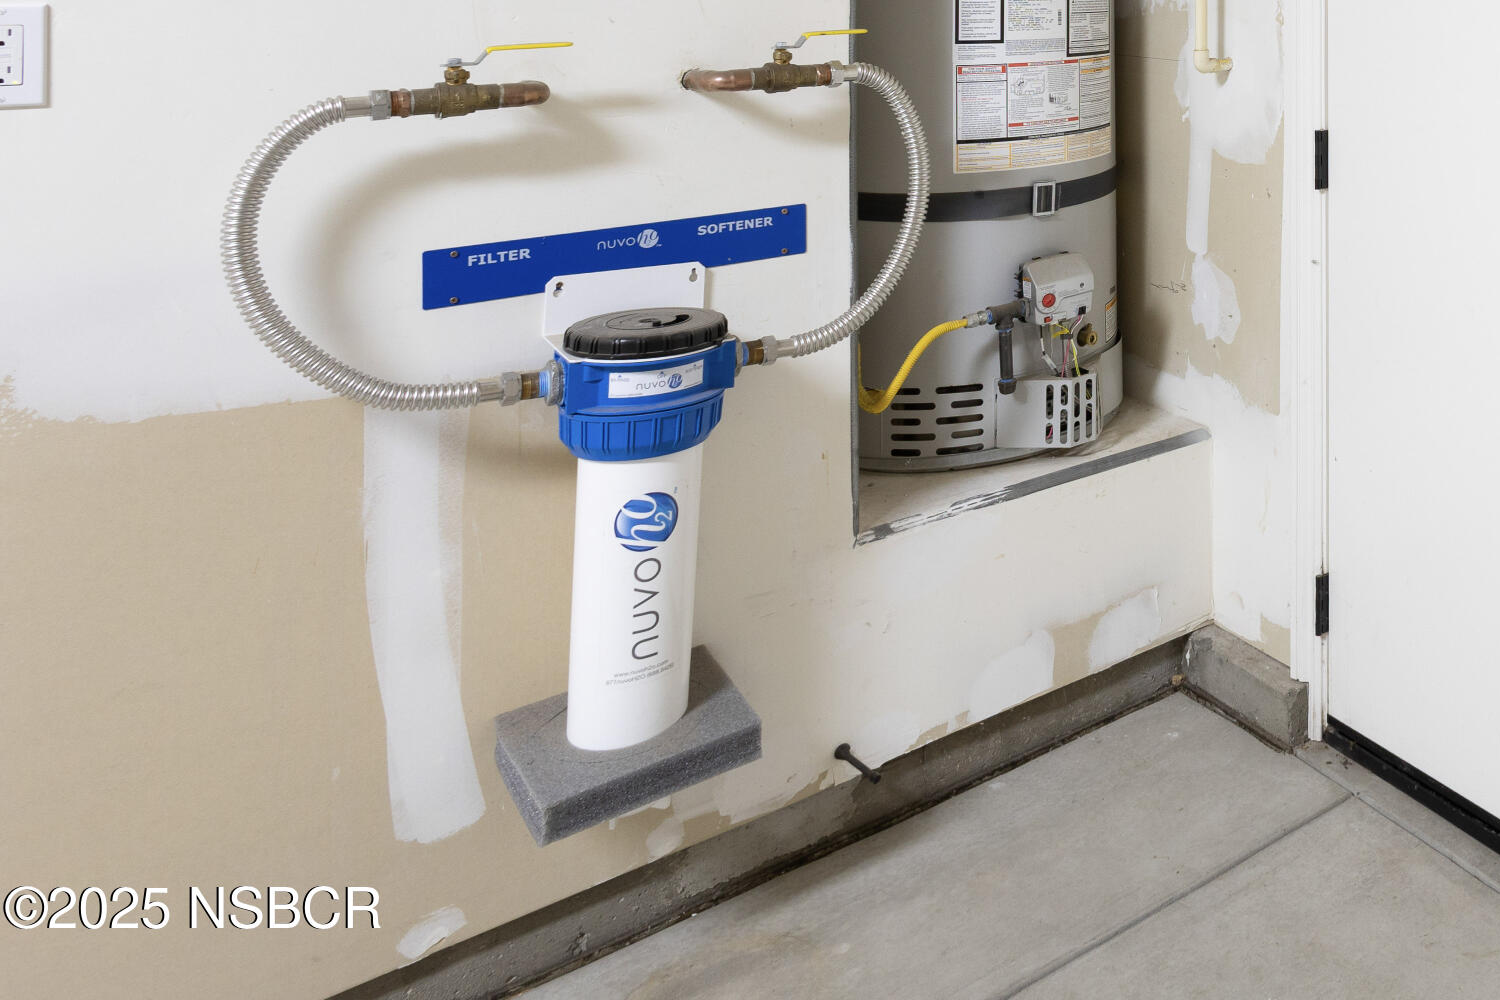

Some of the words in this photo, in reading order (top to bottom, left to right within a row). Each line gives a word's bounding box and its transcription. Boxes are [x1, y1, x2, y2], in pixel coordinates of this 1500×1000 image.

[697, 216, 774, 236] SOFTENER
[597, 237, 636, 251] nuvo
[467, 248, 531, 267] FILTER
[632, 558, 662, 660] nuvo
